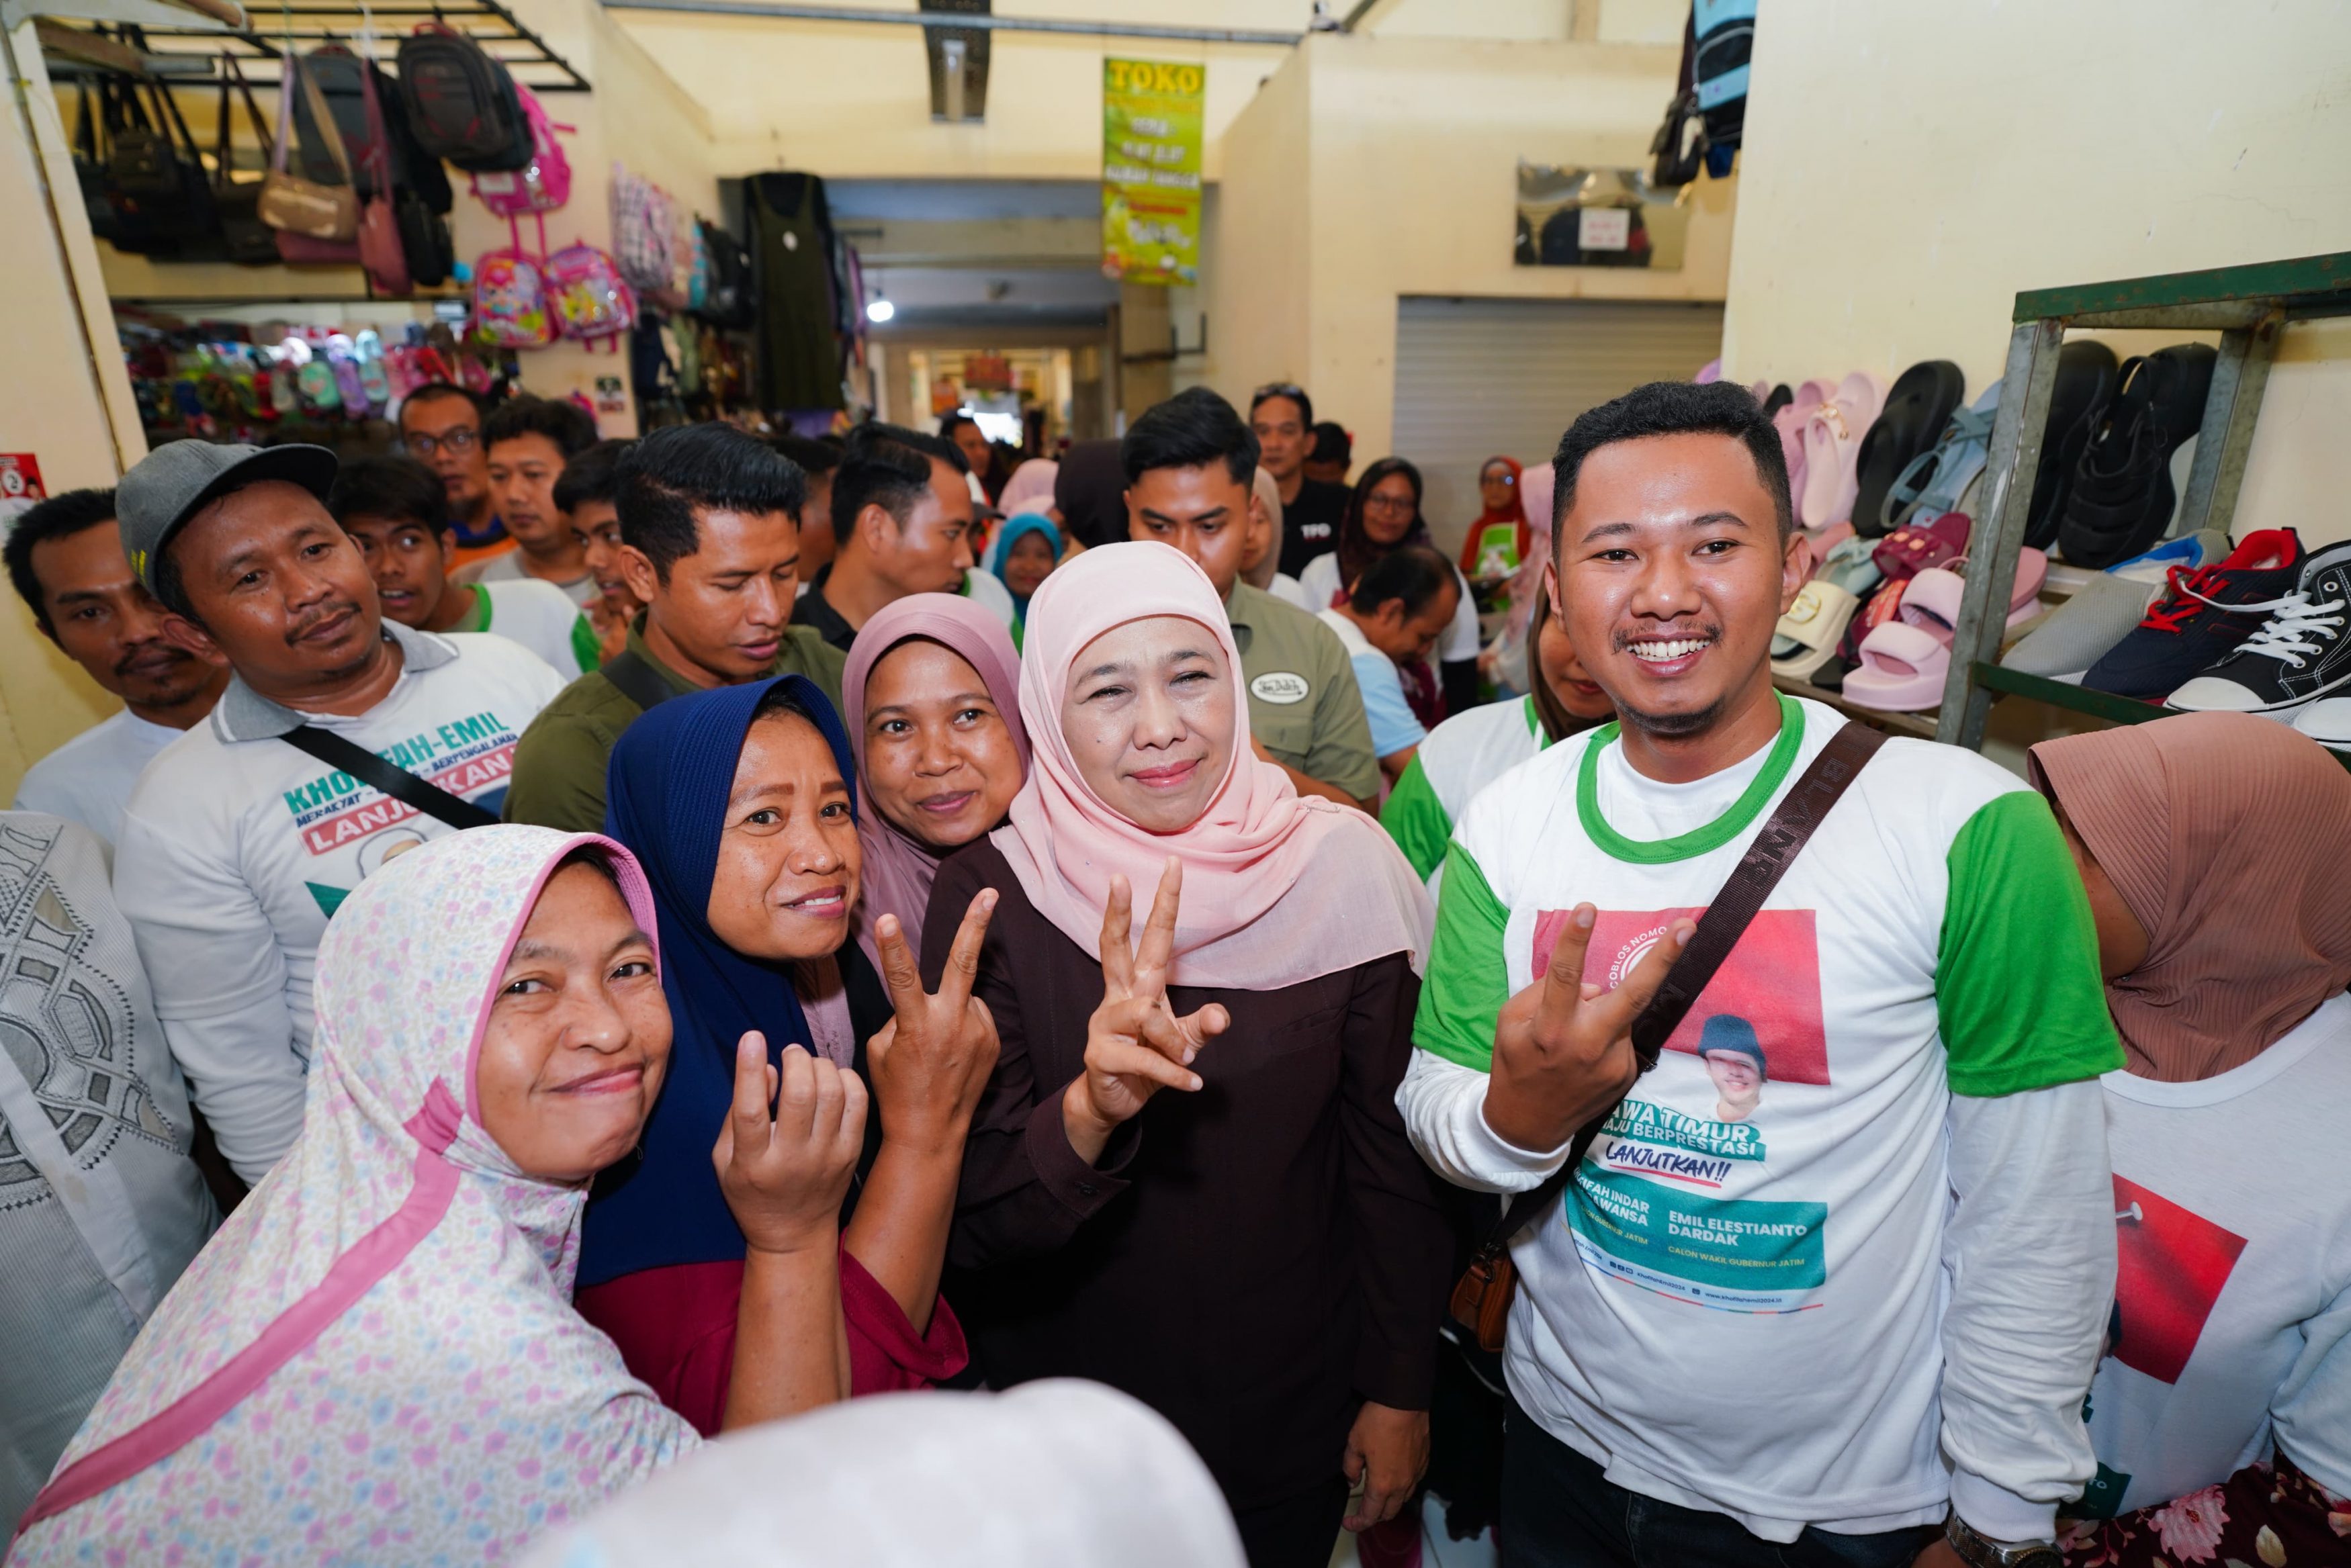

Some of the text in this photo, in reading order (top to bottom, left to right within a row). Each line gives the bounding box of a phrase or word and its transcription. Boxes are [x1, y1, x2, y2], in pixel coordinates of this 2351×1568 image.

[1110, 60, 1199, 94] TOKO
[283, 712, 509, 815] KHOFAH-EMIL
[296, 792, 361, 827] MERAKYAT
[1609, 945, 1631, 988] COBLOS
[1633, 1122, 1756, 1156] BERPRESTASI
[1661, 1108, 1751, 1142] TIMUR
[1606, 1142, 1732, 1182] LANJUTKAN!!
[1611, 1190, 1650, 1213] INDAR
[1624, 1232, 1648, 1245] JATIM
[1669, 1210, 1807, 1236] EMIL ELESTIANTO
[1669, 1224, 1738, 1246] DARDAK
[1669, 1246, 1804, 1268] CALON WAKIL GUBERNUR JATIM
